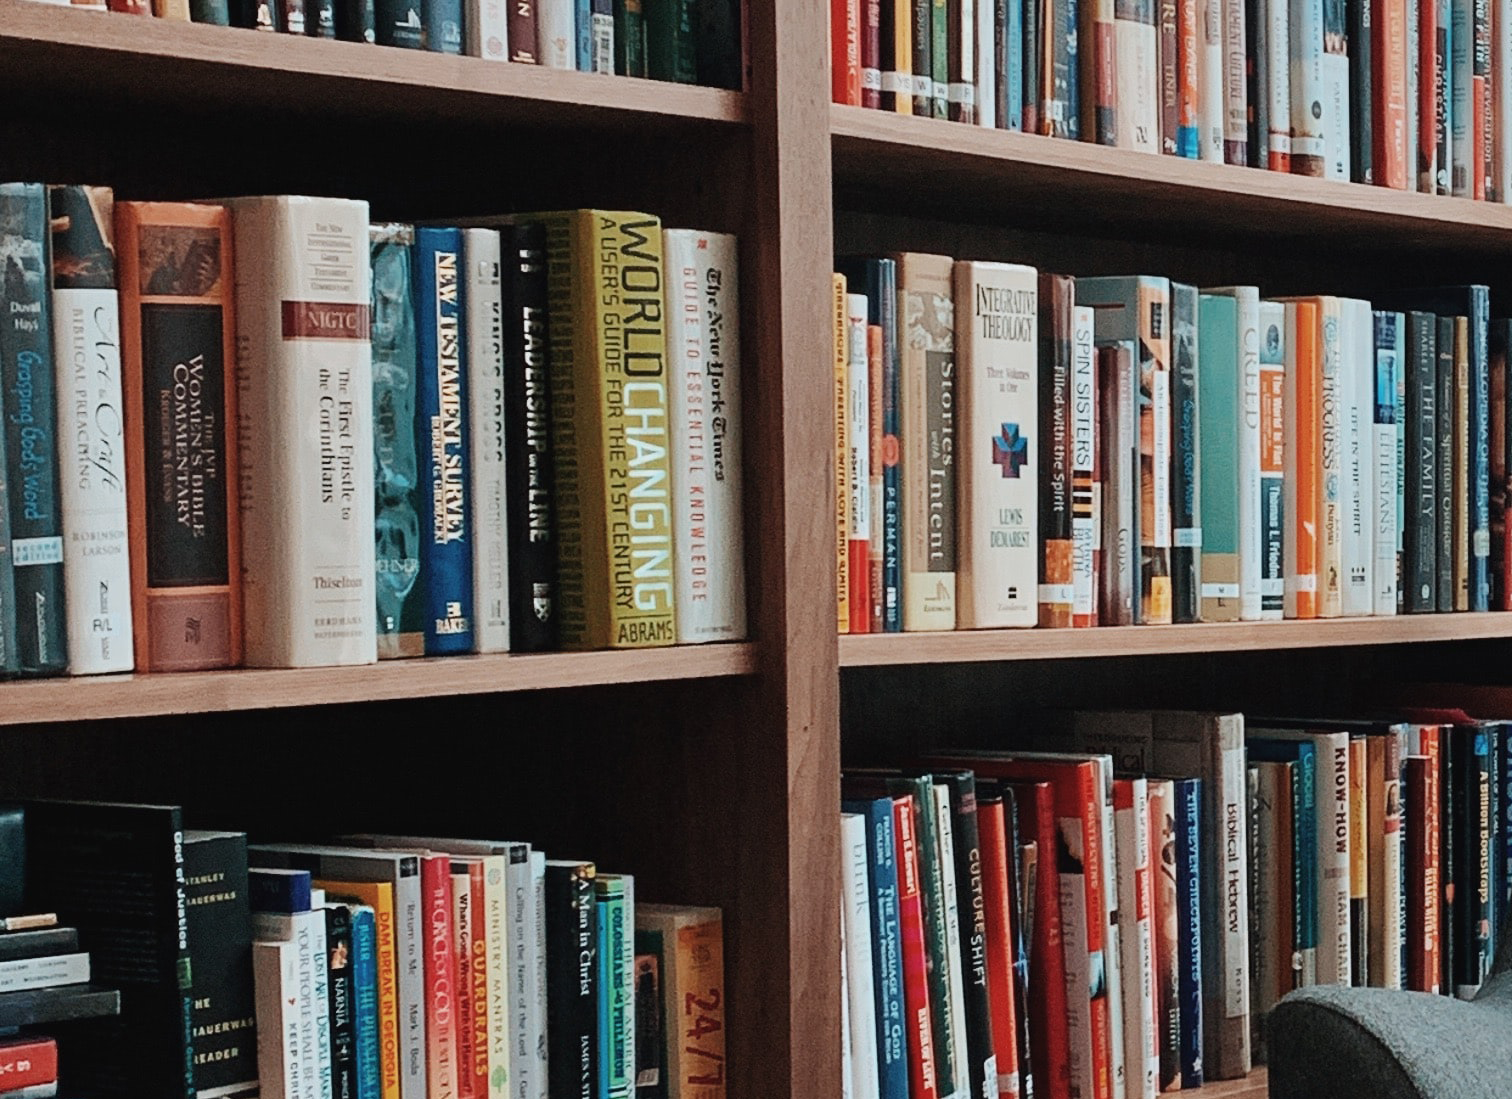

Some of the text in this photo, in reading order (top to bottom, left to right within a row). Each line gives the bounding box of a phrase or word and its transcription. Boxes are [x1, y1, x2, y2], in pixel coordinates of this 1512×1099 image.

[308, 310, 357, 330] NIGTC
[976, 283, 1036, 316] INTEGRATIVE
[982, 315, 1032, 342] THEOLOGY
[15, 352, 42, 424] Grasping
[72, 308, 91, 489] BIBLICAL PREACHING
[438, 252, 466, 543] NEW TESTAMENT SURVEY
[600, 217, 632, 610] A USER'S GUIDE FOR THE 21ST CENTURY
[619, 219, 673, 611] WORLDCHANGING
[706, 267, 728, 482] The New York Times
[941, 361, 954, 466] Stories
[1077, 328, 1091, 466] SPIN SISTERS
[1243, 327, 1258, 430] CREED
[1321, 375, 1335, 470] PROGRESS
[85, 402, 124, 493] Craft
[173, 363, 190, 528] COMMENTARY
[188, 354, 206, 538] WOMEN'S BIBLE
[319, 368, 338, 503] the Corinthians
[338, 368, 355, 521] The First Epistle to
[683, 267, 707, 601] GUIDE TO ESSENTIAL KNOWLEDGE
[1052, 366, 1066, 512] Filled with the Spirit
[1351, 406, 1361, 537] LIFE IN THE SPIRIT
[1379, 432, 1392, 534] EPHESIANS
[1423, 382, 1433, 517] THE FAMILY
[21, 477, 46, 521] Word
[73, 530, 125, 542] ROBINSON
[886, 486, 897, 568] PERMAN
[930, 467, 946, 561] Intent
[990, 531, 1030, 548] DEMAREST
[999, 509, 1022, 527] LEWIS
[82, 545, 122, 556] LARSON
[618, 619, 673, 645] ABRAMS
[1087, 801, 1098, 889] MULTIPLYING
[1335, 747, 1347, 853] KNOW-HOW
[1478, 771, 1489, 903] A Billion Bootstraps
[174, 831, 188, 949] God of Justice
[459, 894, 469, 930] What's
[853, 842, 867, 914] blink
[1187, 793, 1201, 982] THE SEVEN CHECKPOINTS
[1226, 802, 1240, 933] Biblical Hebrew
[298, 927, 309, 967] YOUR
[407, 904, 418, 940] Return
[408, 943, 417, 956] to
[459, 931, 470, 959] Gone
[578, 879, 593, 995] A Man in Christ
[968, 848, 985, 986] CULTURESHIFT
[300, 971, 310, 1019] PEOPLE
[334, 977, 345, 1026] NARNIA
[380, 912, 397, 1088] DAM BREAK IN GEORGIA
[459, 960, 470, 998] Wrong
[460, 999, 471, 1024] With
[474, 939, 487, 1076] GUARDRAILS
[491, 900, 503, 1053] MINISTRY MANTRAS
[515, 887, 529, 1056] Calling on the Name of the Lord
[885, 885, 902, 1059] THE LANGUAGE OF GOD
[289, 1023, 298, 1058] KEEP
[302, 1021, 311, 1062] SHALL
[303, 1066, 312, 1083] BE
[461, 1026, 471, 1042] the
[685, 988, 723, 1086] 24/7
